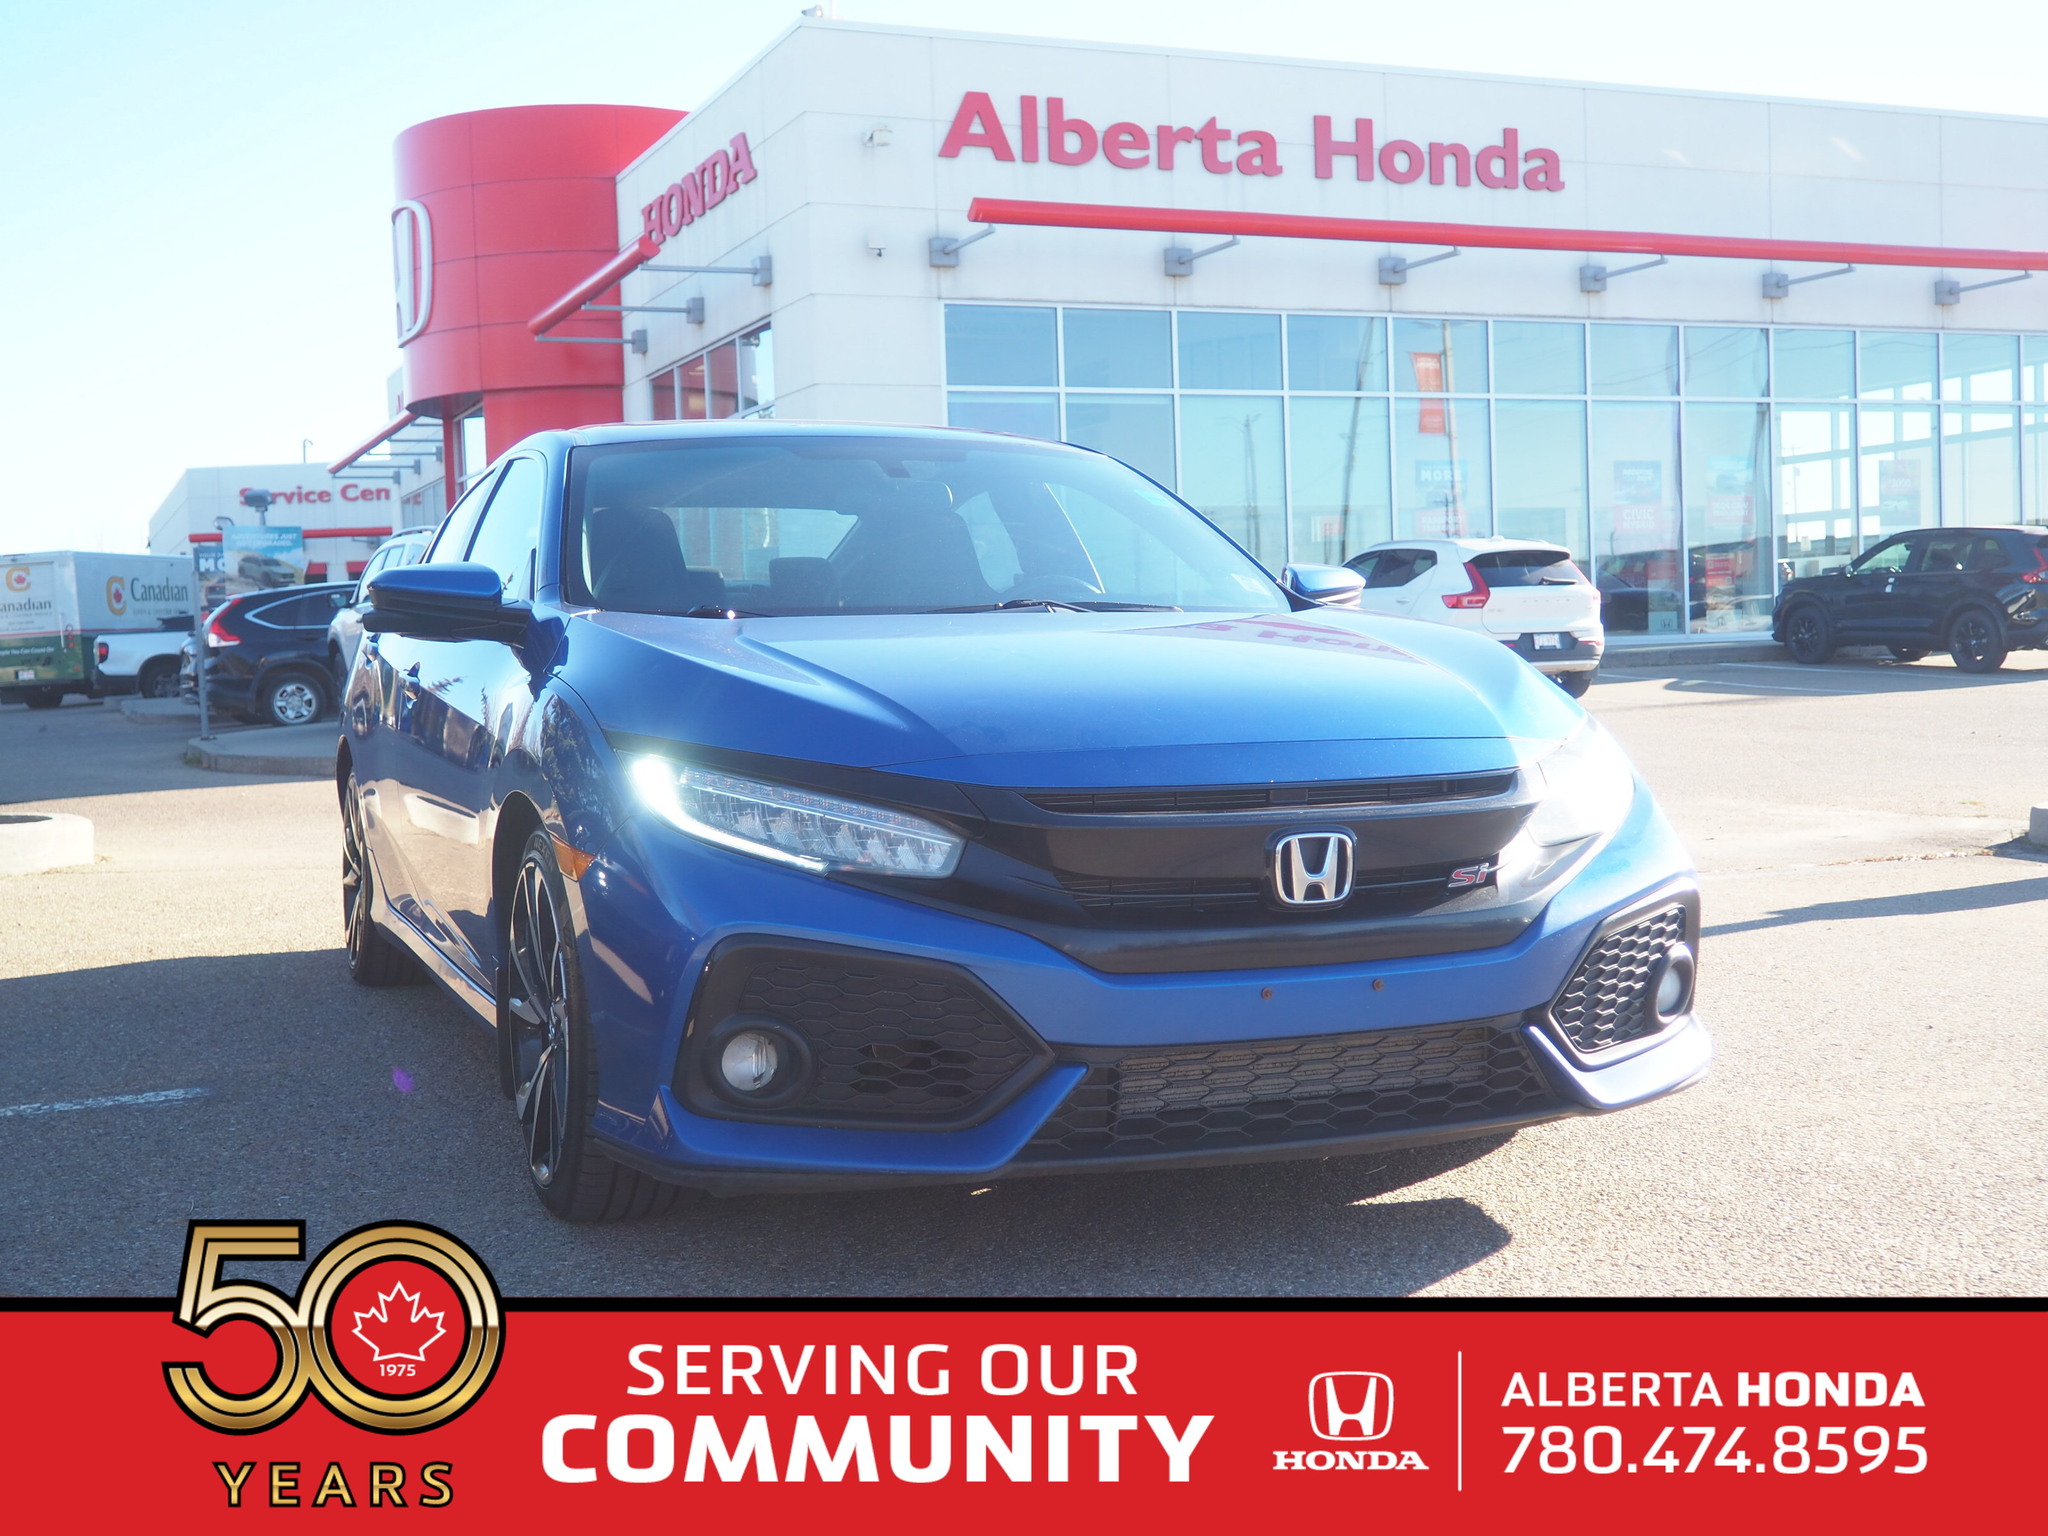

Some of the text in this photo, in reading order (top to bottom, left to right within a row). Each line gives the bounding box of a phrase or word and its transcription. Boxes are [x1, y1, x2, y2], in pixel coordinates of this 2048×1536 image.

[938, 90, 1566, 192] Alberta Honda
[641, 131, 758, 246] HONDA
[239, 485, 332, 504] Srvice
[1623, 508, 1655, 521] CIVIC
[130, 577, 189, 604] Canadian
[1448, 862, 1490, 888] Si
